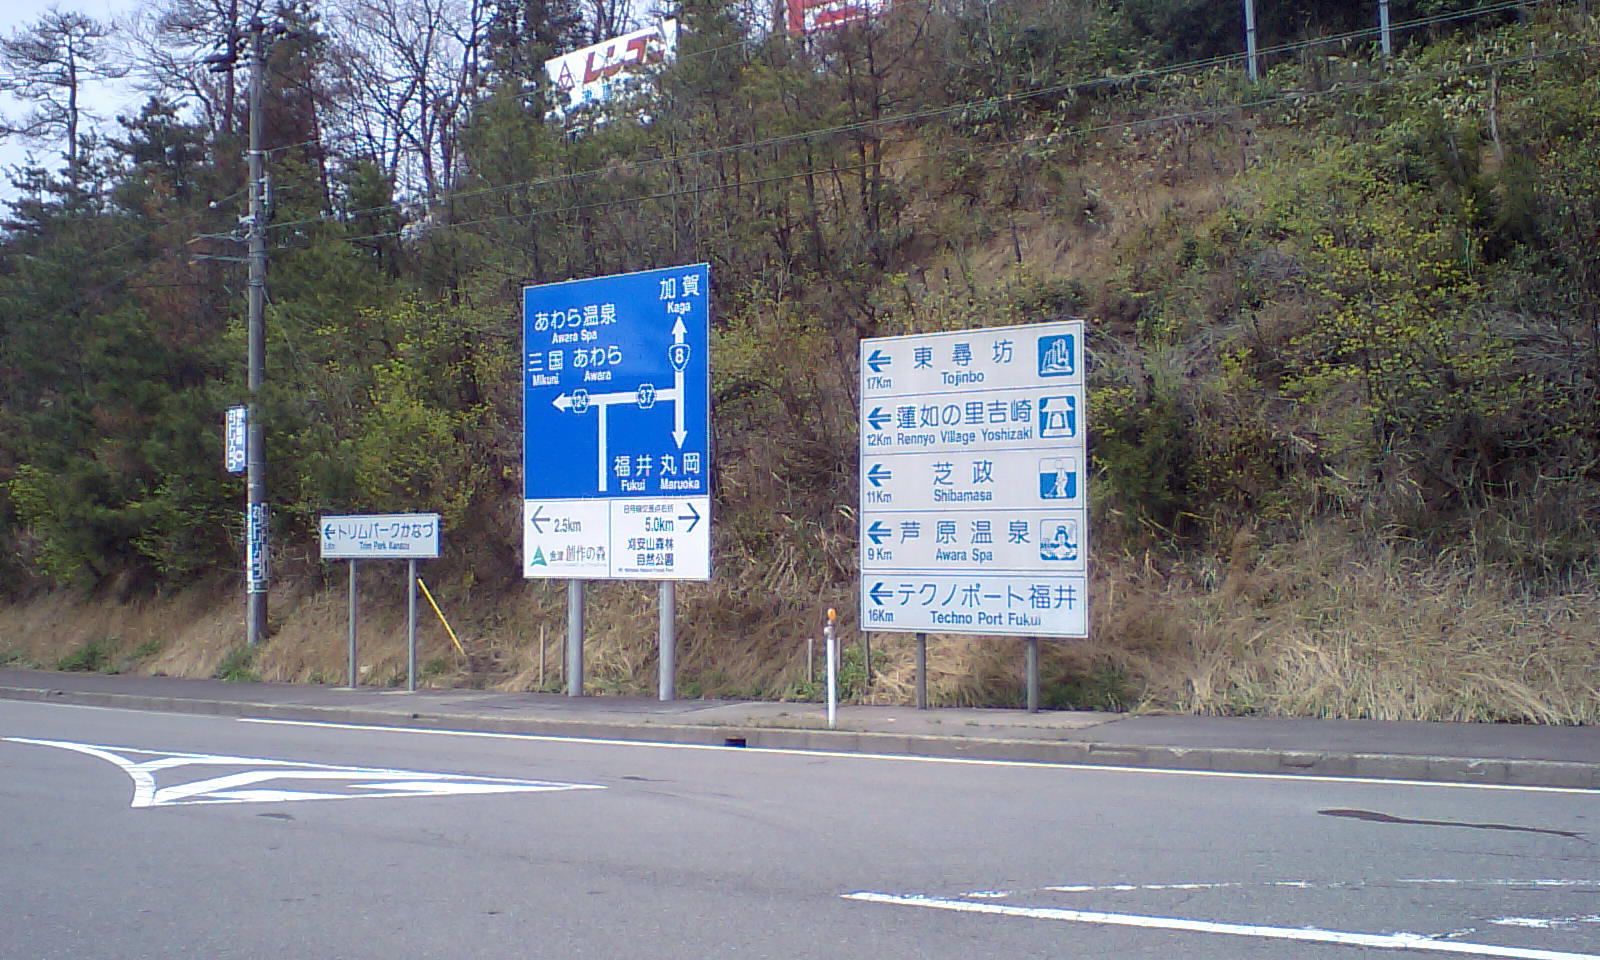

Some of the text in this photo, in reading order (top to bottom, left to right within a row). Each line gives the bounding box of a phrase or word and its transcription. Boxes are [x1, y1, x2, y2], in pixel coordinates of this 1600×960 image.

[660, 274, 700, 300] 加賀
[667, 301, 691, 314] Kaga
[534, 303, 617, 331] あわら温泉
[552, 329, 598, 344] Awara Spa
[528, 346, 622, 371] 三国 あわら
[675, 349, 684, 364] 8
[913, 340, 1013, 369] 東尋坊
[532, 373, 560, 386] Mikuni
[584, 370, 612, 382] Awara
[867, 377, 892, 389] 17Km
[941, 370, 985, 386] Tojinbo
[573, 395, 587, 408] 124
[640, 390, 652, 402] 37
[896, 400, 1032, 429] 蓮如の里吉崎
[867, 434, 892, 447] 12Km
[897, 427, 1033, 447] Rennyo Village Yoshizaki
[614, 452, 700, 477] 福井 丸岡
[933, 460, 994, 486] 芝政
[621, 479, 646, 491] Fukui
[660, 477, 700, 490] Maruoka
[867, 490, 892, 503] 11Km
[934, 489, 992, 502] Shibamasa
[338, 522, 434, 540] トリムパークかなづ
[554, 518, 582, 533] 2.5km
[645, 517, 674, 532] 5.0km
[900, 520, 1031, 545] 芦原温泉
[636, 553, 674, 567] 自然公園
[936, 548, 993, 564] Awara Spa
[898, 583, 1077, 610] テクノポート福井
[868, 609, 894, 622] 16Km
[930, 610, 1041, 626] Techno Port Fukui
